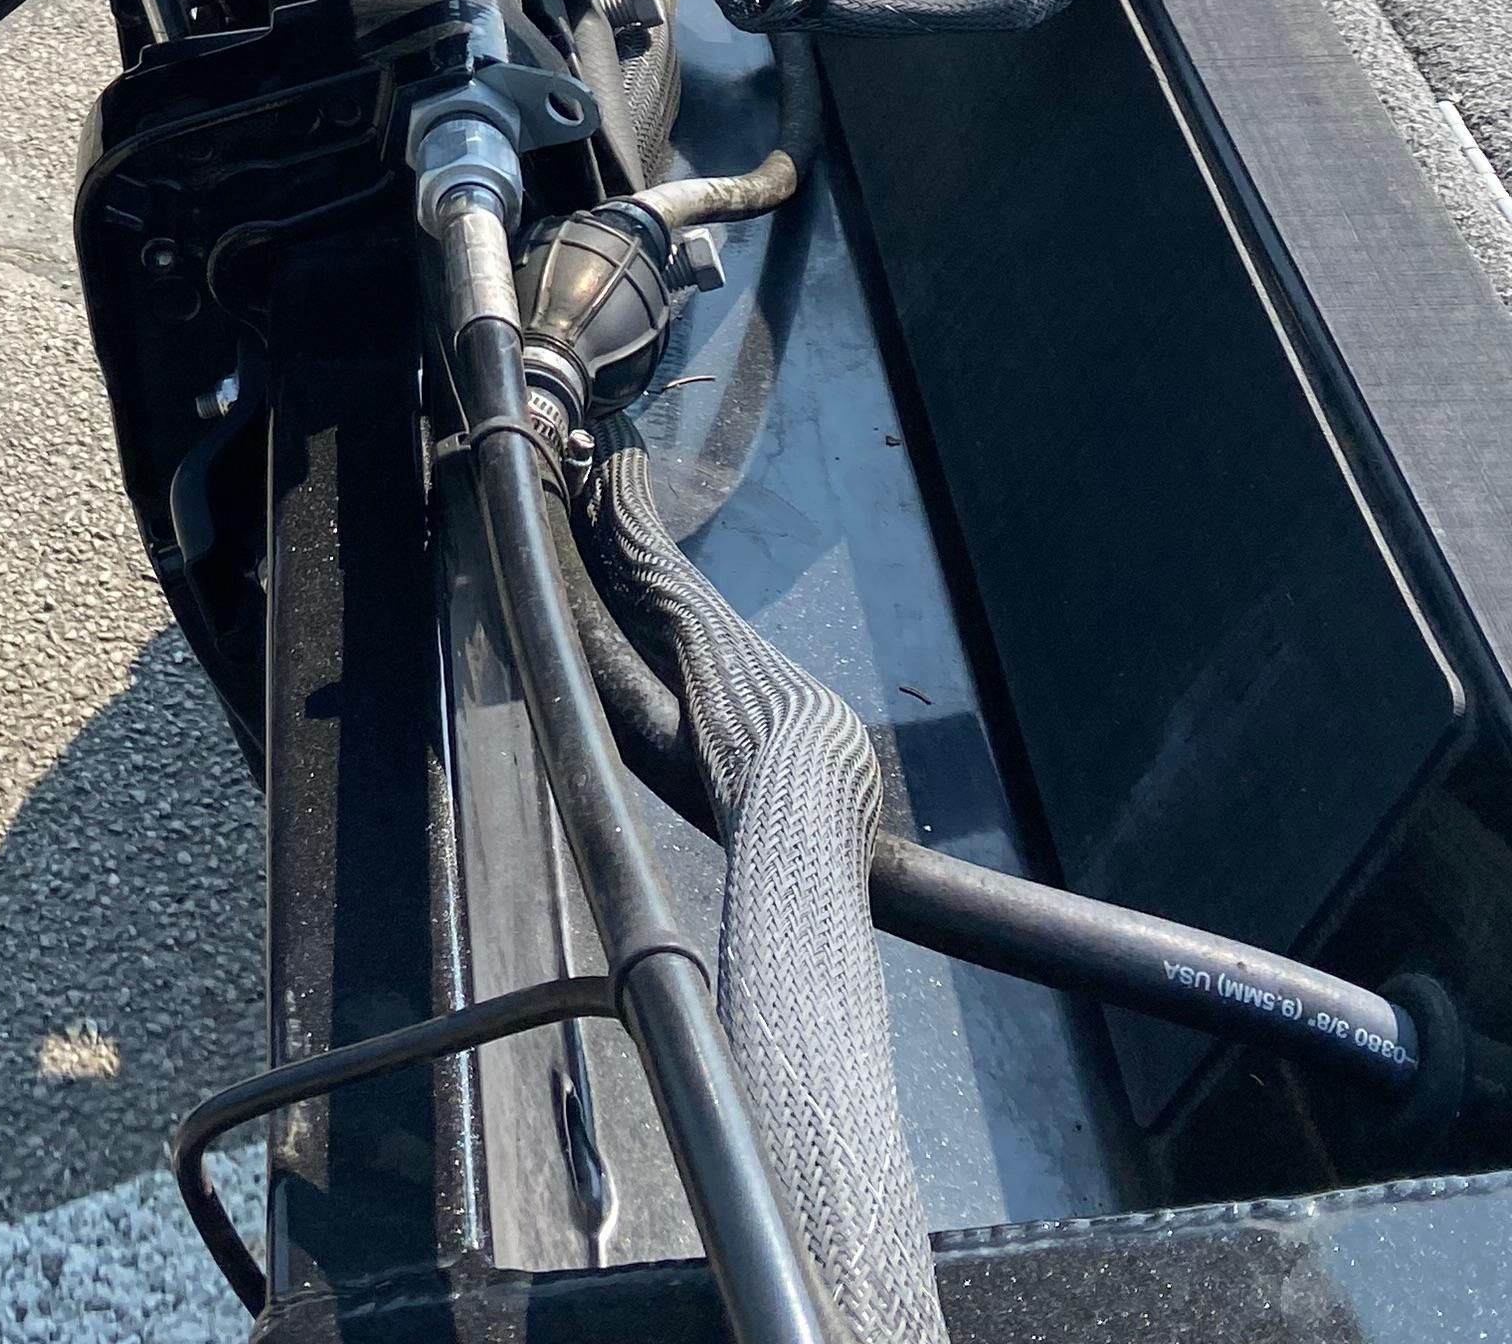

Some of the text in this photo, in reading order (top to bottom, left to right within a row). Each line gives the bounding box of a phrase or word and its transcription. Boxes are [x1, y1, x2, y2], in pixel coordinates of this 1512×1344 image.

[1162, 960, 1211, 991] USA
[1216, 972, 1304, 1021] (9.5MM)
[1307, 1012, 1350, 1039] 3/8"
